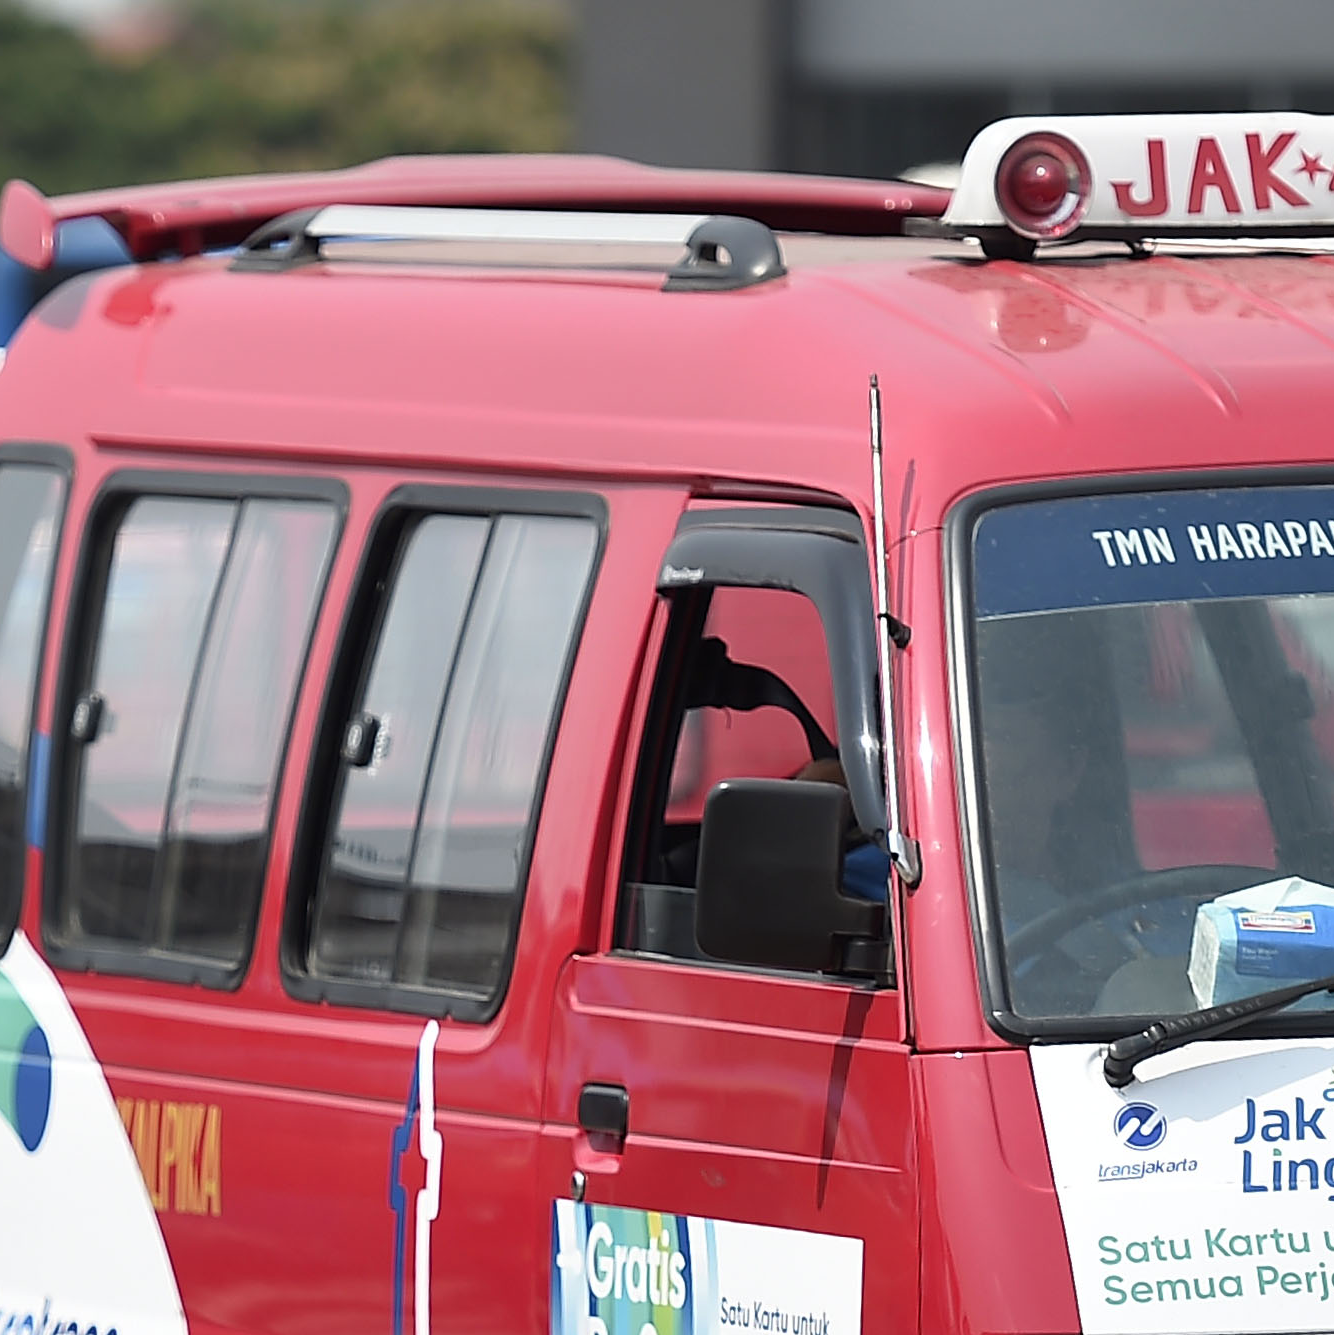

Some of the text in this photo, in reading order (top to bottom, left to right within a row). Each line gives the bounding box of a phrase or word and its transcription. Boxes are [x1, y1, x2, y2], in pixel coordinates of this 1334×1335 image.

[1109, 131, 1311, 218] JAK
[1092, 526, 1176, 568] TMN
[1234, 1097, 1327, 1144] Jak
[1098, 1158, 1198, 1182] transjakarta
[585, 1220, 687, 1309] Gratis
[1098, 1234, 1192, 1266] Satu
[1204, 1225, 1311, 1259] Kartu
[1103, 1274, 1244, 1305] Semua
[720, 1296, 750, 1328] Satu
[753, 1300, 788, 1333] Kartu
